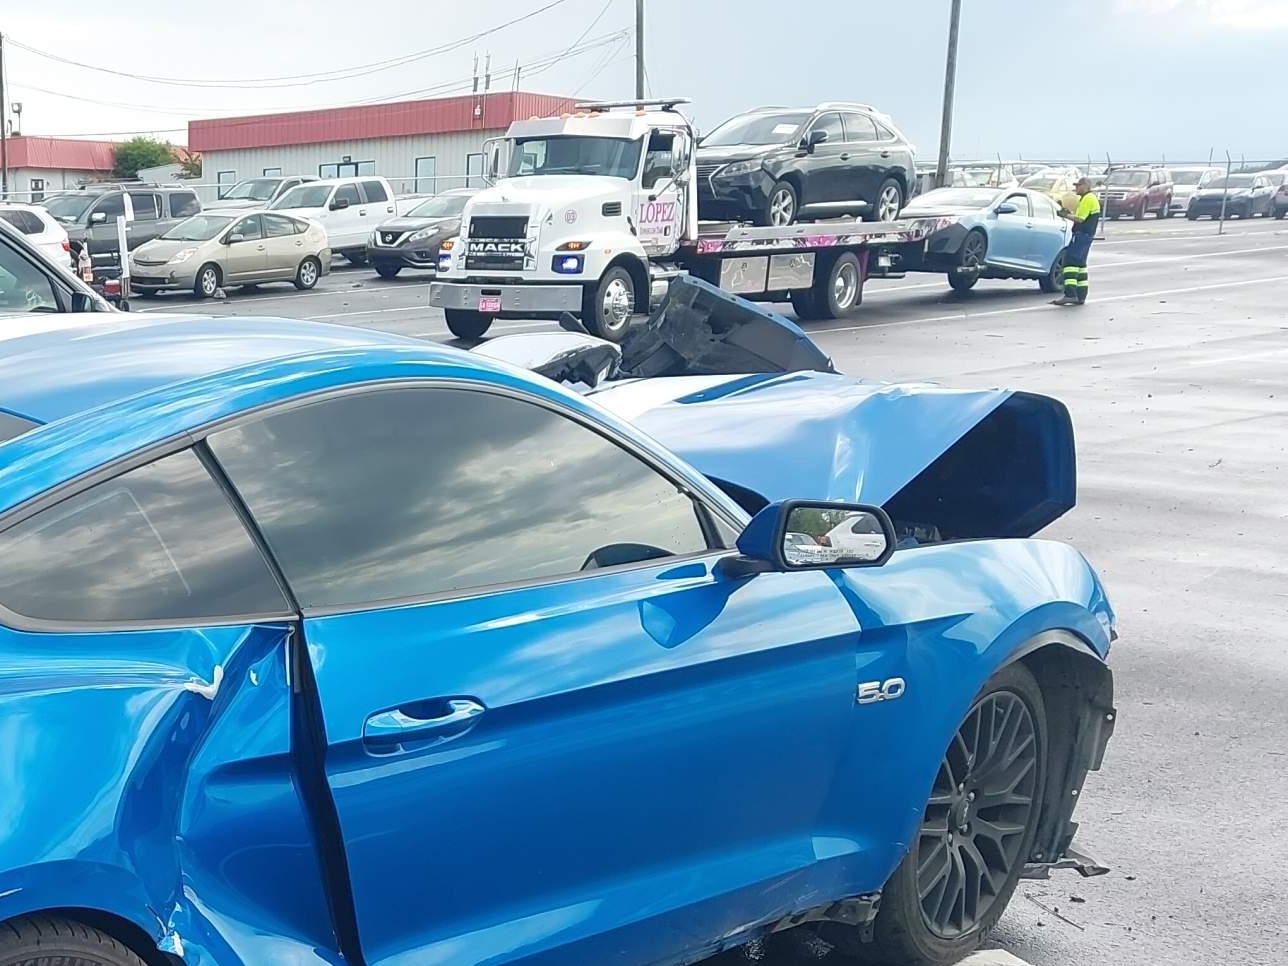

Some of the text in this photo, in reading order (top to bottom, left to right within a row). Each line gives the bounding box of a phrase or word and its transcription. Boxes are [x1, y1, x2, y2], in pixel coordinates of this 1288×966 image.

[639, 202, 675, 223] LOPEZ
[470, 243, 524, 252] MACK
[857, 677, 906, 704] 5.0
